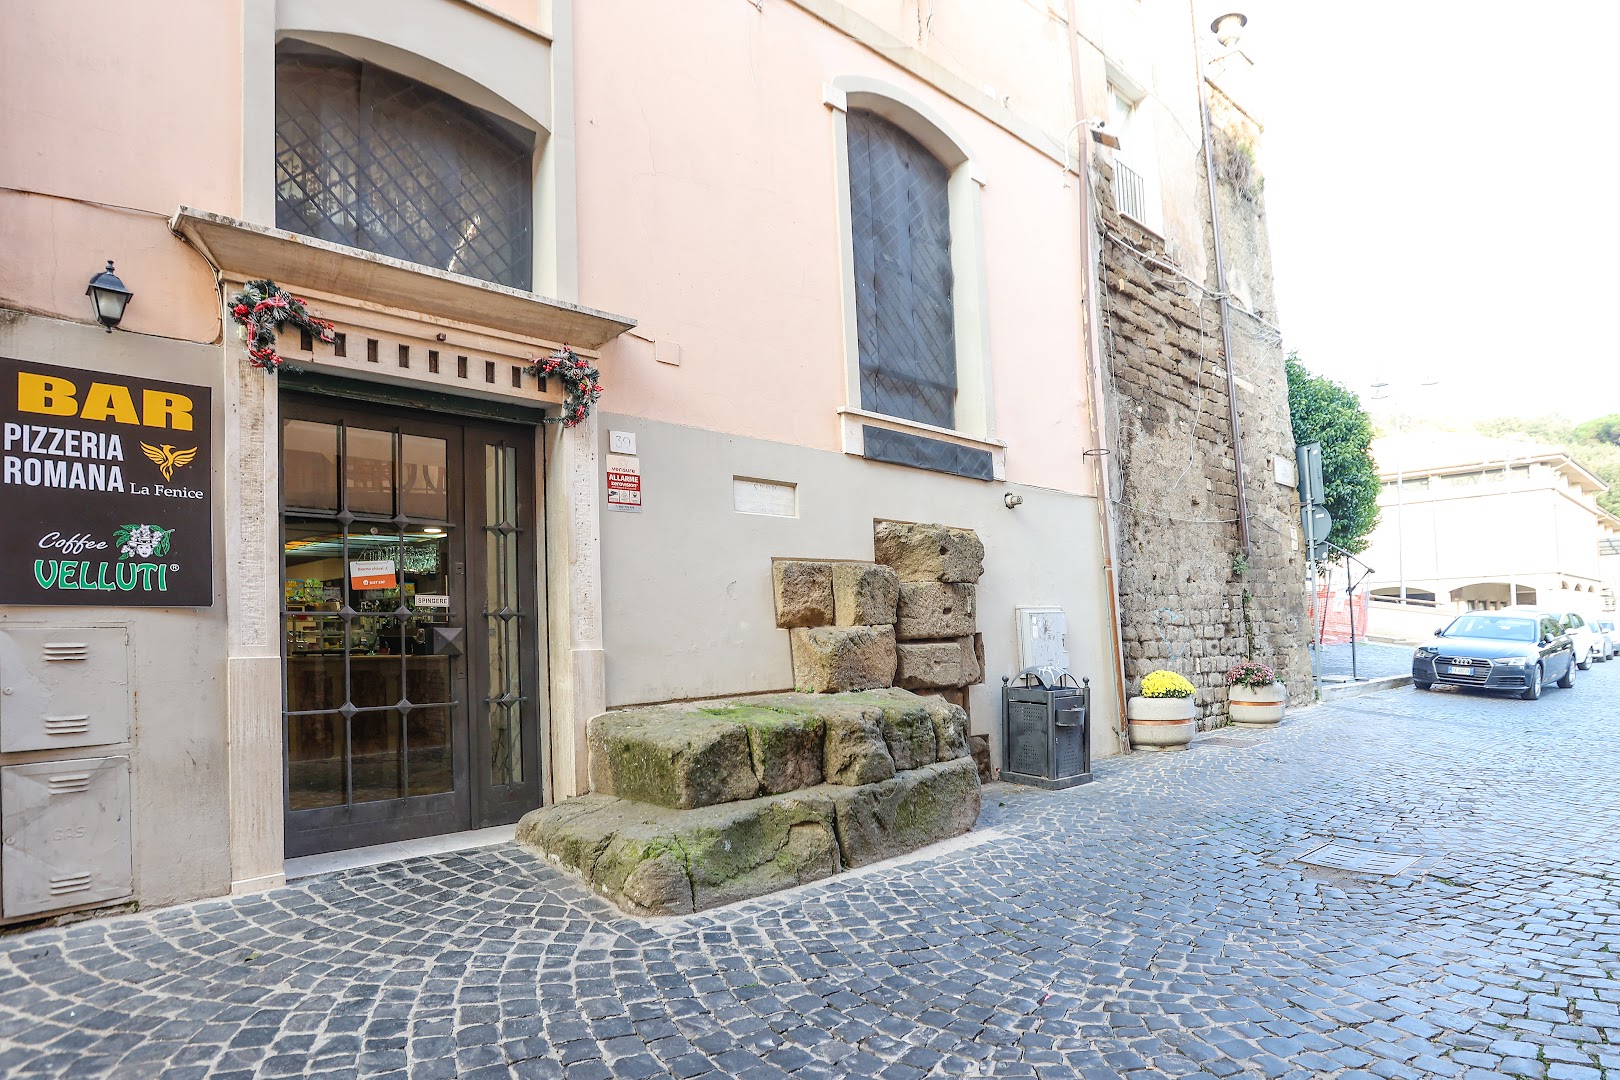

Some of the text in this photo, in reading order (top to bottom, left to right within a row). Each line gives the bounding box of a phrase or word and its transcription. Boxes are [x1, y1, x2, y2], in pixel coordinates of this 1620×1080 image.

[18, 371, 193, 431] BAR
[4, 422, 124, 461] PIZZERIA
[615, 435, 631, 449] 39
[4, 456, 124, 492] ROMANA
[609, 474, 639, 483] ALLARME
[129, 482, 204, 499] La Fenice
[38, 531, 108, 555] Coffee
[34, 559, 167, 591] VELLUTI
[53, 825, 85, 841] GAS
